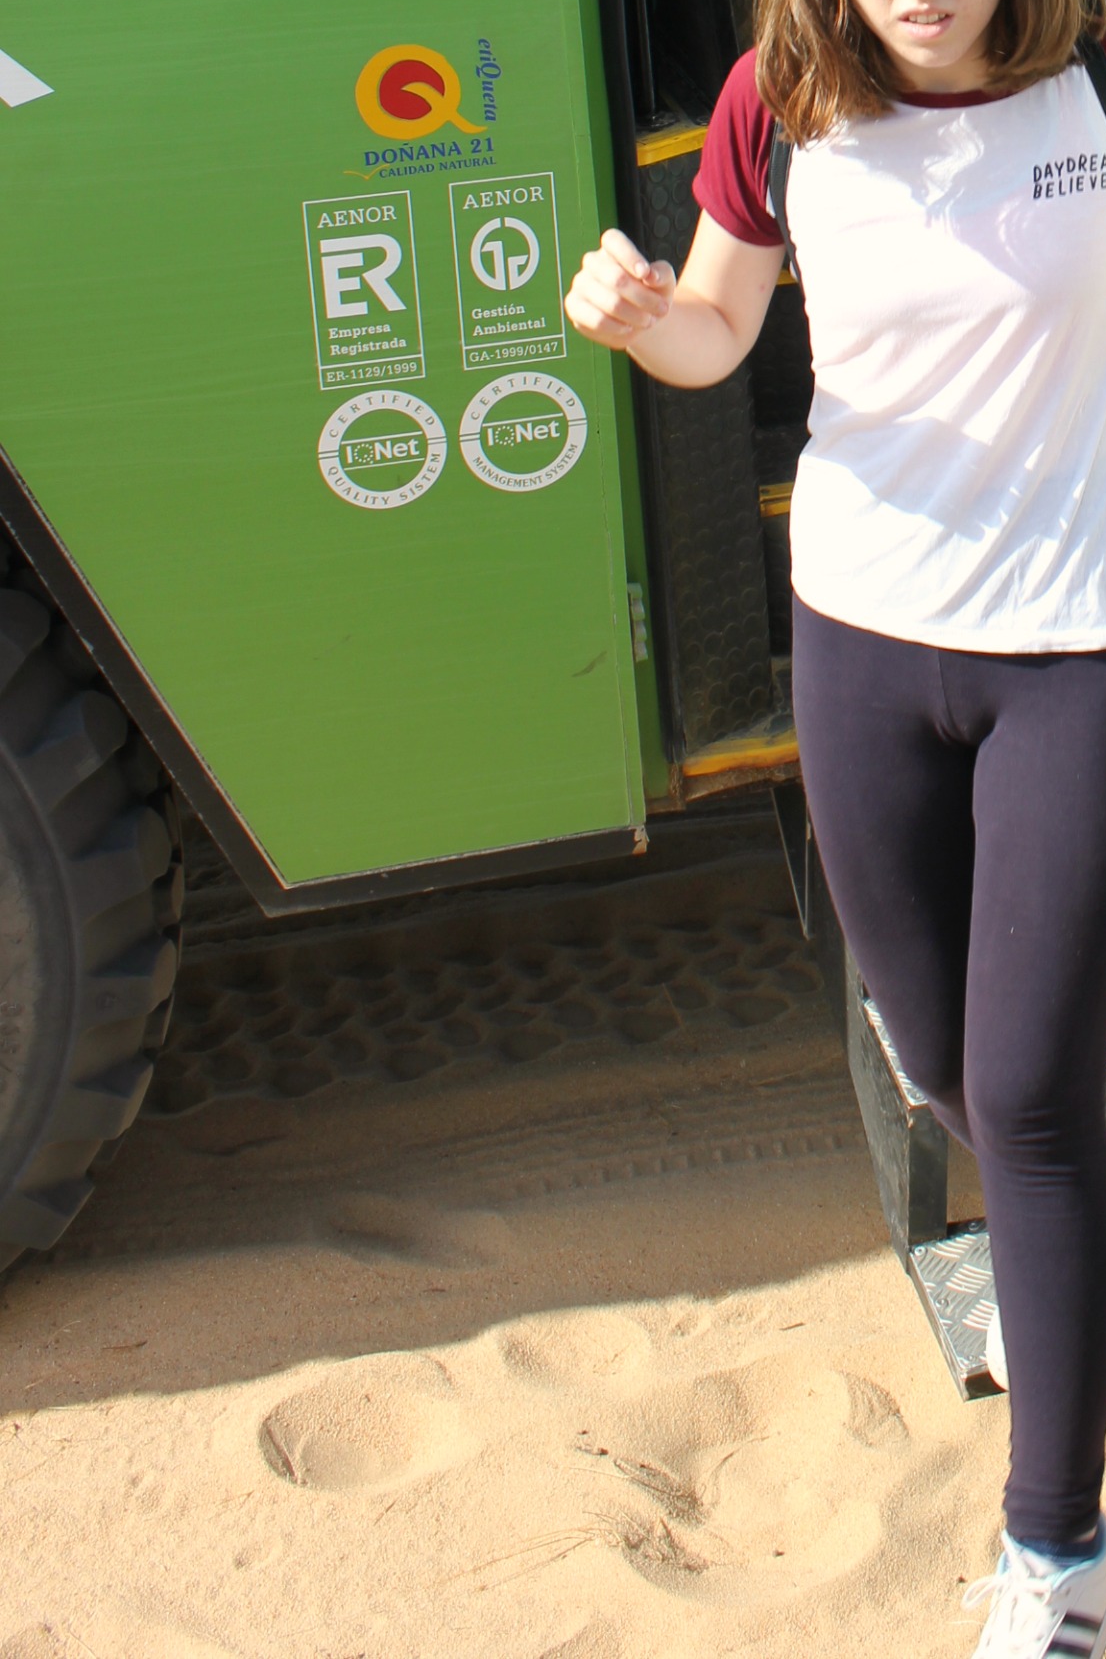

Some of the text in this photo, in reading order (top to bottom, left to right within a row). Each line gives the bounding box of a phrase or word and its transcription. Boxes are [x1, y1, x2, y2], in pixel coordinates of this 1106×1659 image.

[476, 38, 502, 122] etiQueta
[364, 137, 494, 166] DOÑANA 21
[379, 156, 497, 179] CALIDAD NATURAL
[463, 186, 545, 210] AENOR
[317, 205, 397, 229] AENOR
[471, 303, 526, 320] Gestión
[328, 323, 391, 340] Empresa
[472, 317, 546, 337] Ambiental
[330, 337, 407, 357] Registrada
[469, 341, 559, 363] GA-1999/0147
[327, 361, 418, 383] ER-1129/1999
[471, 375, 576, 421] CERTIFIED
[329, 394, 435, 438] CERTIFIED
[487, 420, 561, 447] IQNet
[346, 438, 420, 464] IQNet
[473, 443, 578, 488] MANAGEMENT SYSTEM
[328, 453, 441, 505] QUALITY SISTEM
